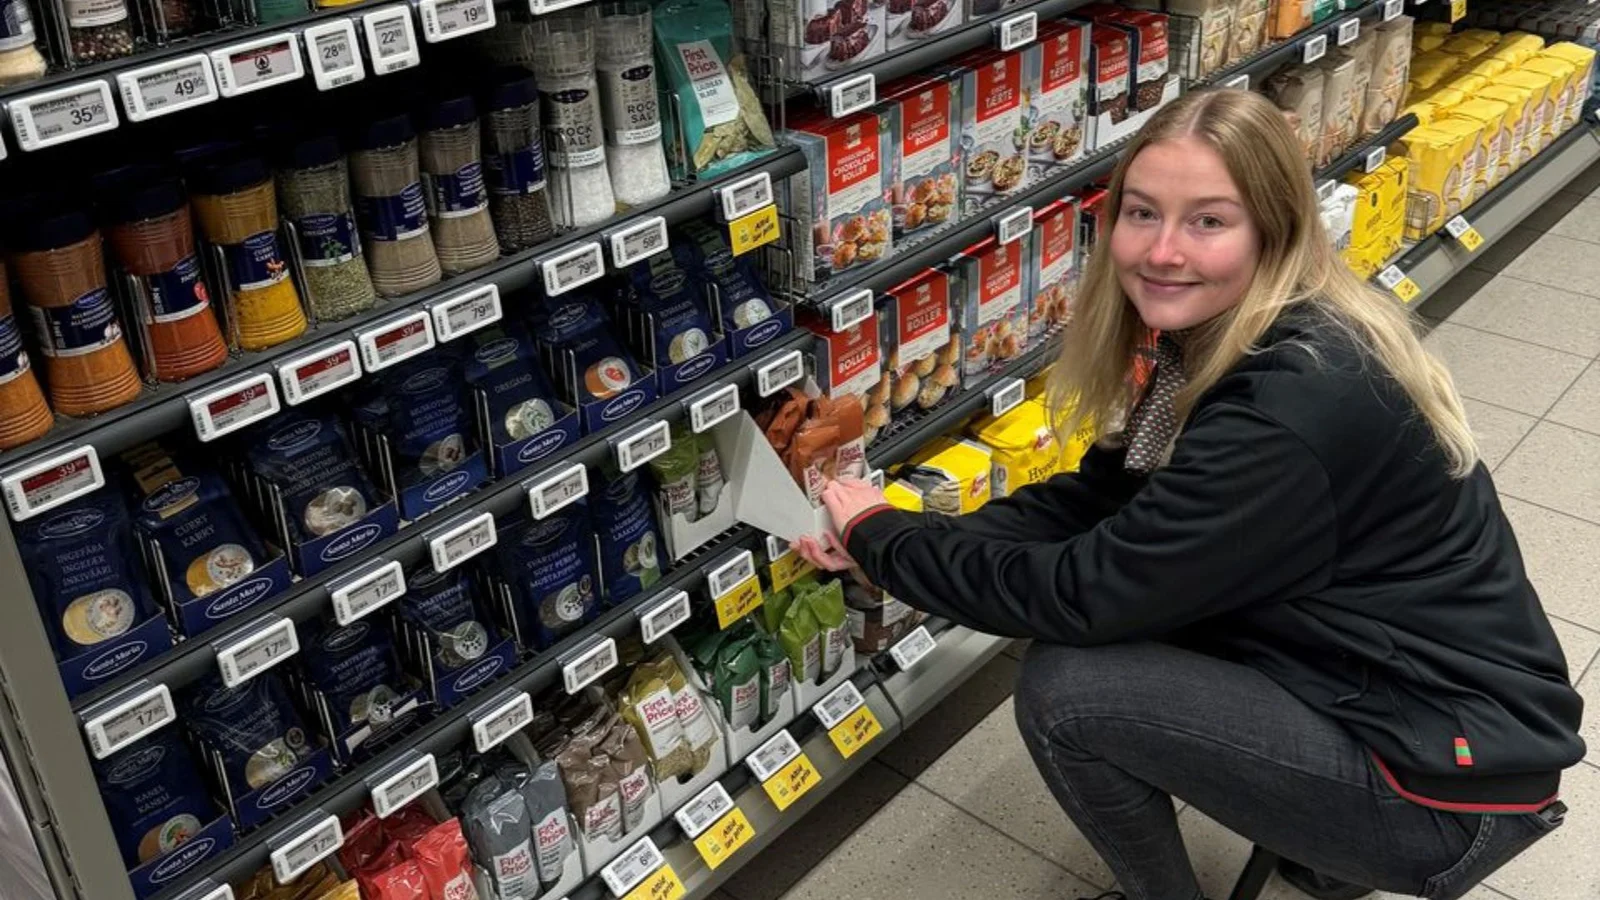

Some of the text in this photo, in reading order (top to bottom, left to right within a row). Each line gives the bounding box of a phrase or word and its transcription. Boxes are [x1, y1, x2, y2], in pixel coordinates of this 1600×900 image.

[683, 48, 707, 63] First
[688, 60, 718, 75] Price
[627, 102, 656, 116] ROCK
[642, 696, 667, 714] First
[646, 705, 674, 723] Price
[539, 826, 566, 846] Price
[500, 849, 526, 867] First
[501, 858, 530, 876] Price
